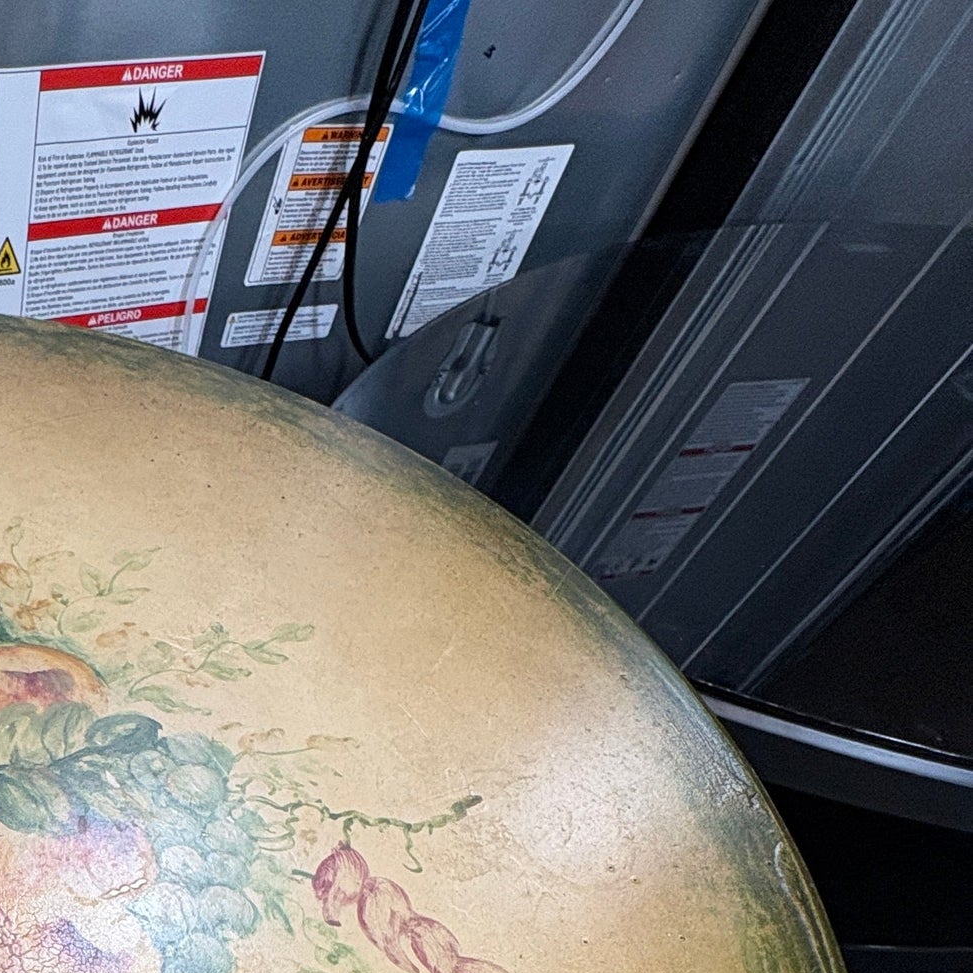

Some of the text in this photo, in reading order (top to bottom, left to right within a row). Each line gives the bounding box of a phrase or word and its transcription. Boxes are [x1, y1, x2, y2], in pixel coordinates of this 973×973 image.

[133, 64, 184, 80] DANGER
[330, 130, 365, 140] WARNIN
[112, 213, 159, 229] DANGER
[97, 309, 142, 325] PELIGRO
